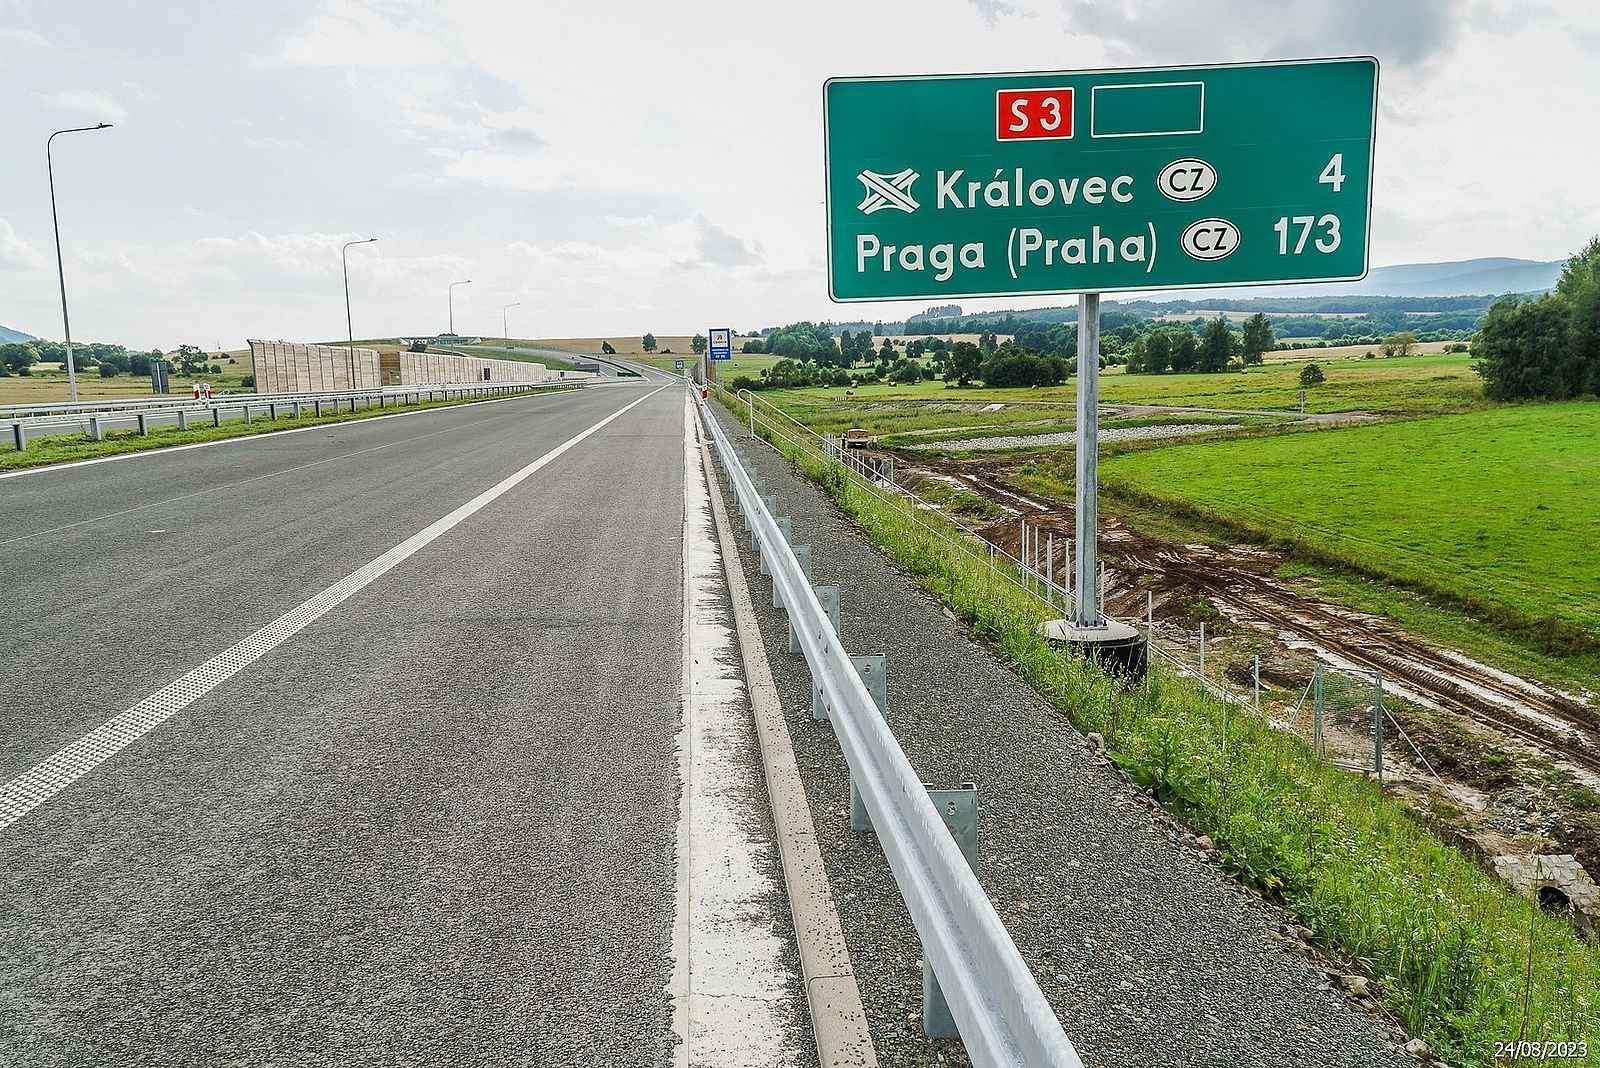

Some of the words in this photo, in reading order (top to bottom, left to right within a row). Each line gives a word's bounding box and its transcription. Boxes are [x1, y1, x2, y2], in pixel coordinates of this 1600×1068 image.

[937, 167, 1134, 209] Královec
[1169, 168, 1204, 193] CZ
[1318, 153, 1346, 192] 4
[856, 233, 985, 282] Praga
[1007, 222, 1157, 279] (Praha)
[1192, 227, 1229, 252] CZ
[1273, 213, 1341, 255] 173
